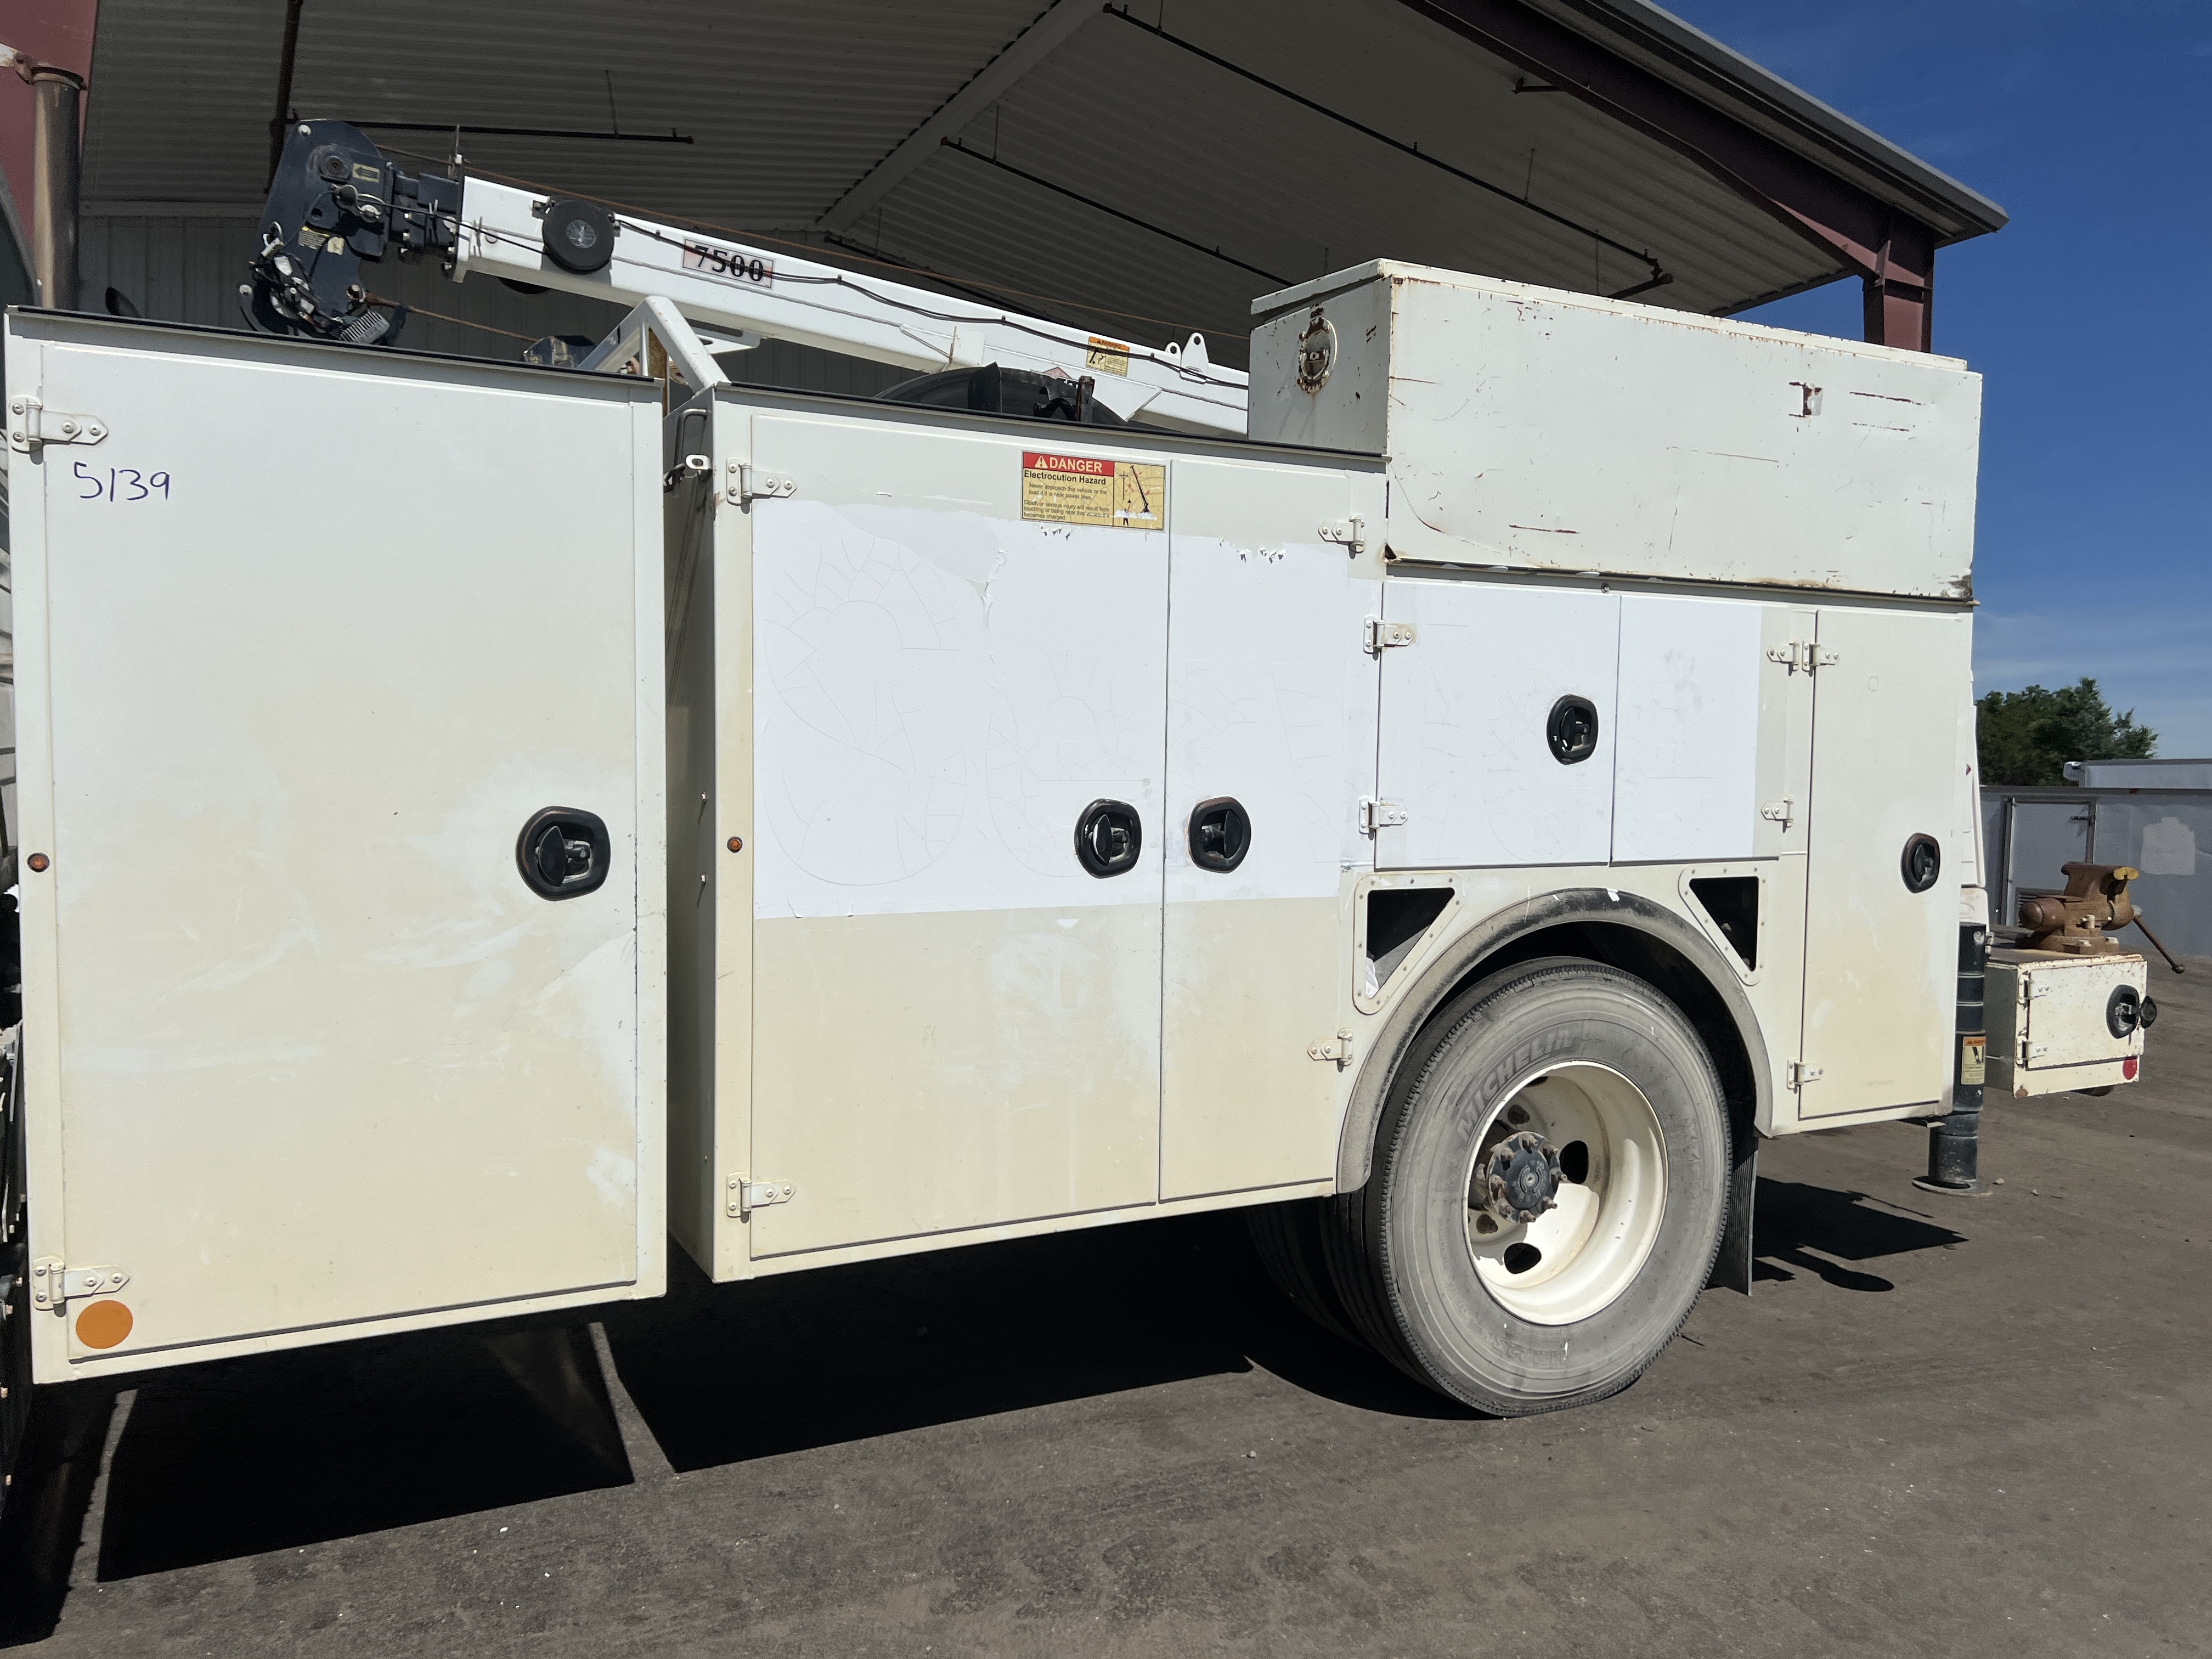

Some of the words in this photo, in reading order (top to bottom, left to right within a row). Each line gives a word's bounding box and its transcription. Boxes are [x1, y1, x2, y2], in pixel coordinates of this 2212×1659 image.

[695, 245, 764, 282] 7500
[74, 461, 170, 503] 5139
[1024, 470, 1077, 483] Electrocution
[1079, 475, 1106, 486] Hazard
[1049, 457, 1103, 473] DANGER
[1456, 1029, 1573, 1145] MICHELIN
